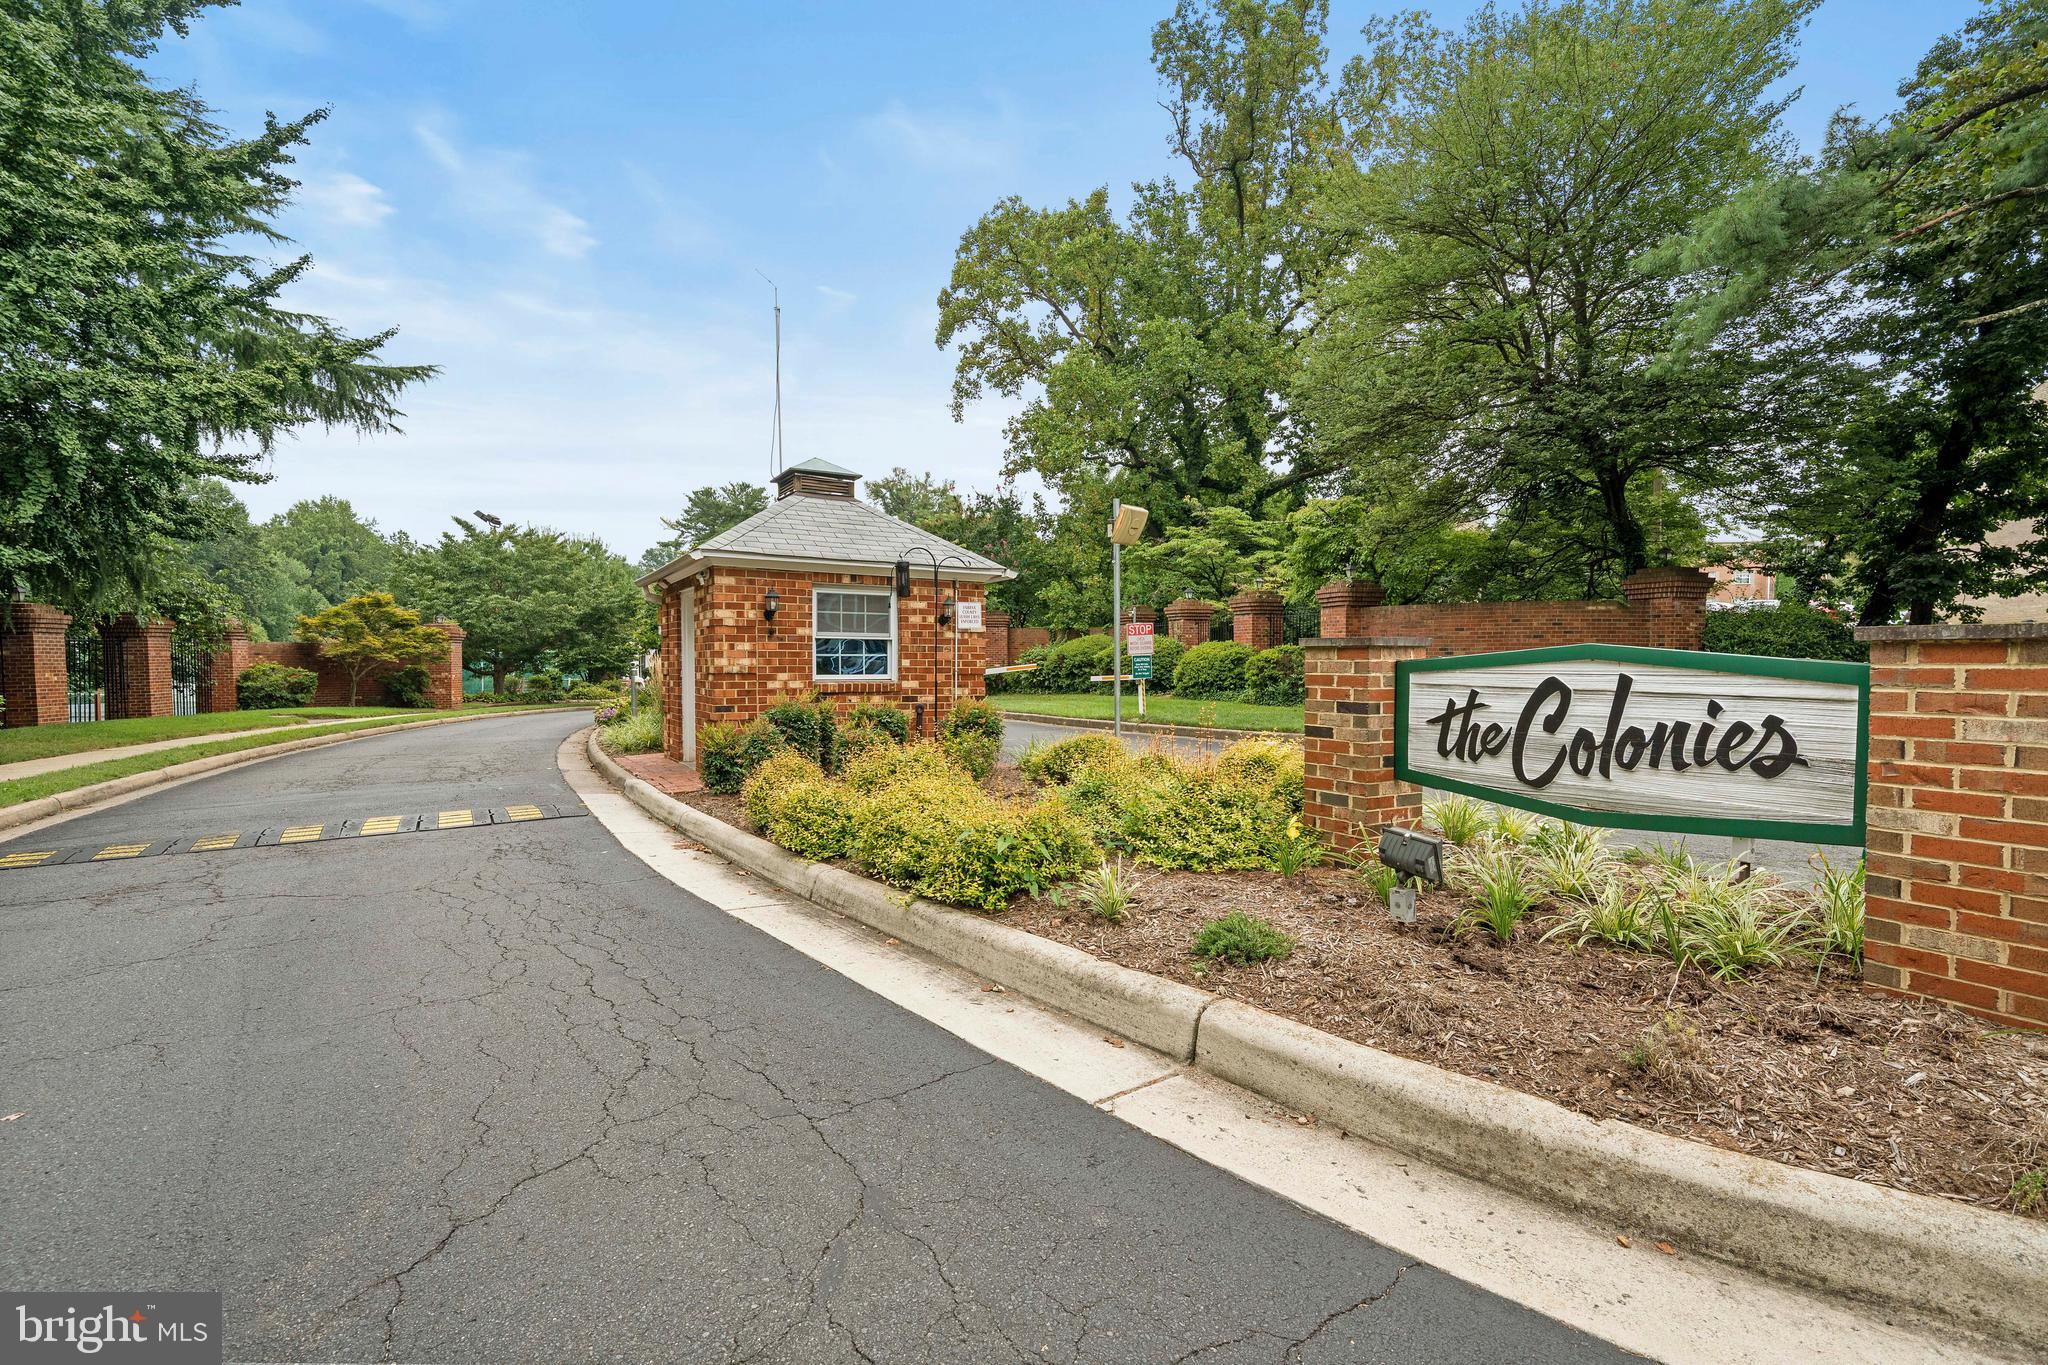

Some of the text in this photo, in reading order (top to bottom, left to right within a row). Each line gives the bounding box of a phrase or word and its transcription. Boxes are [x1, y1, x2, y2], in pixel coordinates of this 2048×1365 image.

[1129, 624, 1152, 635] STOP
[1426, 673, 1811, 788] the Colonies
